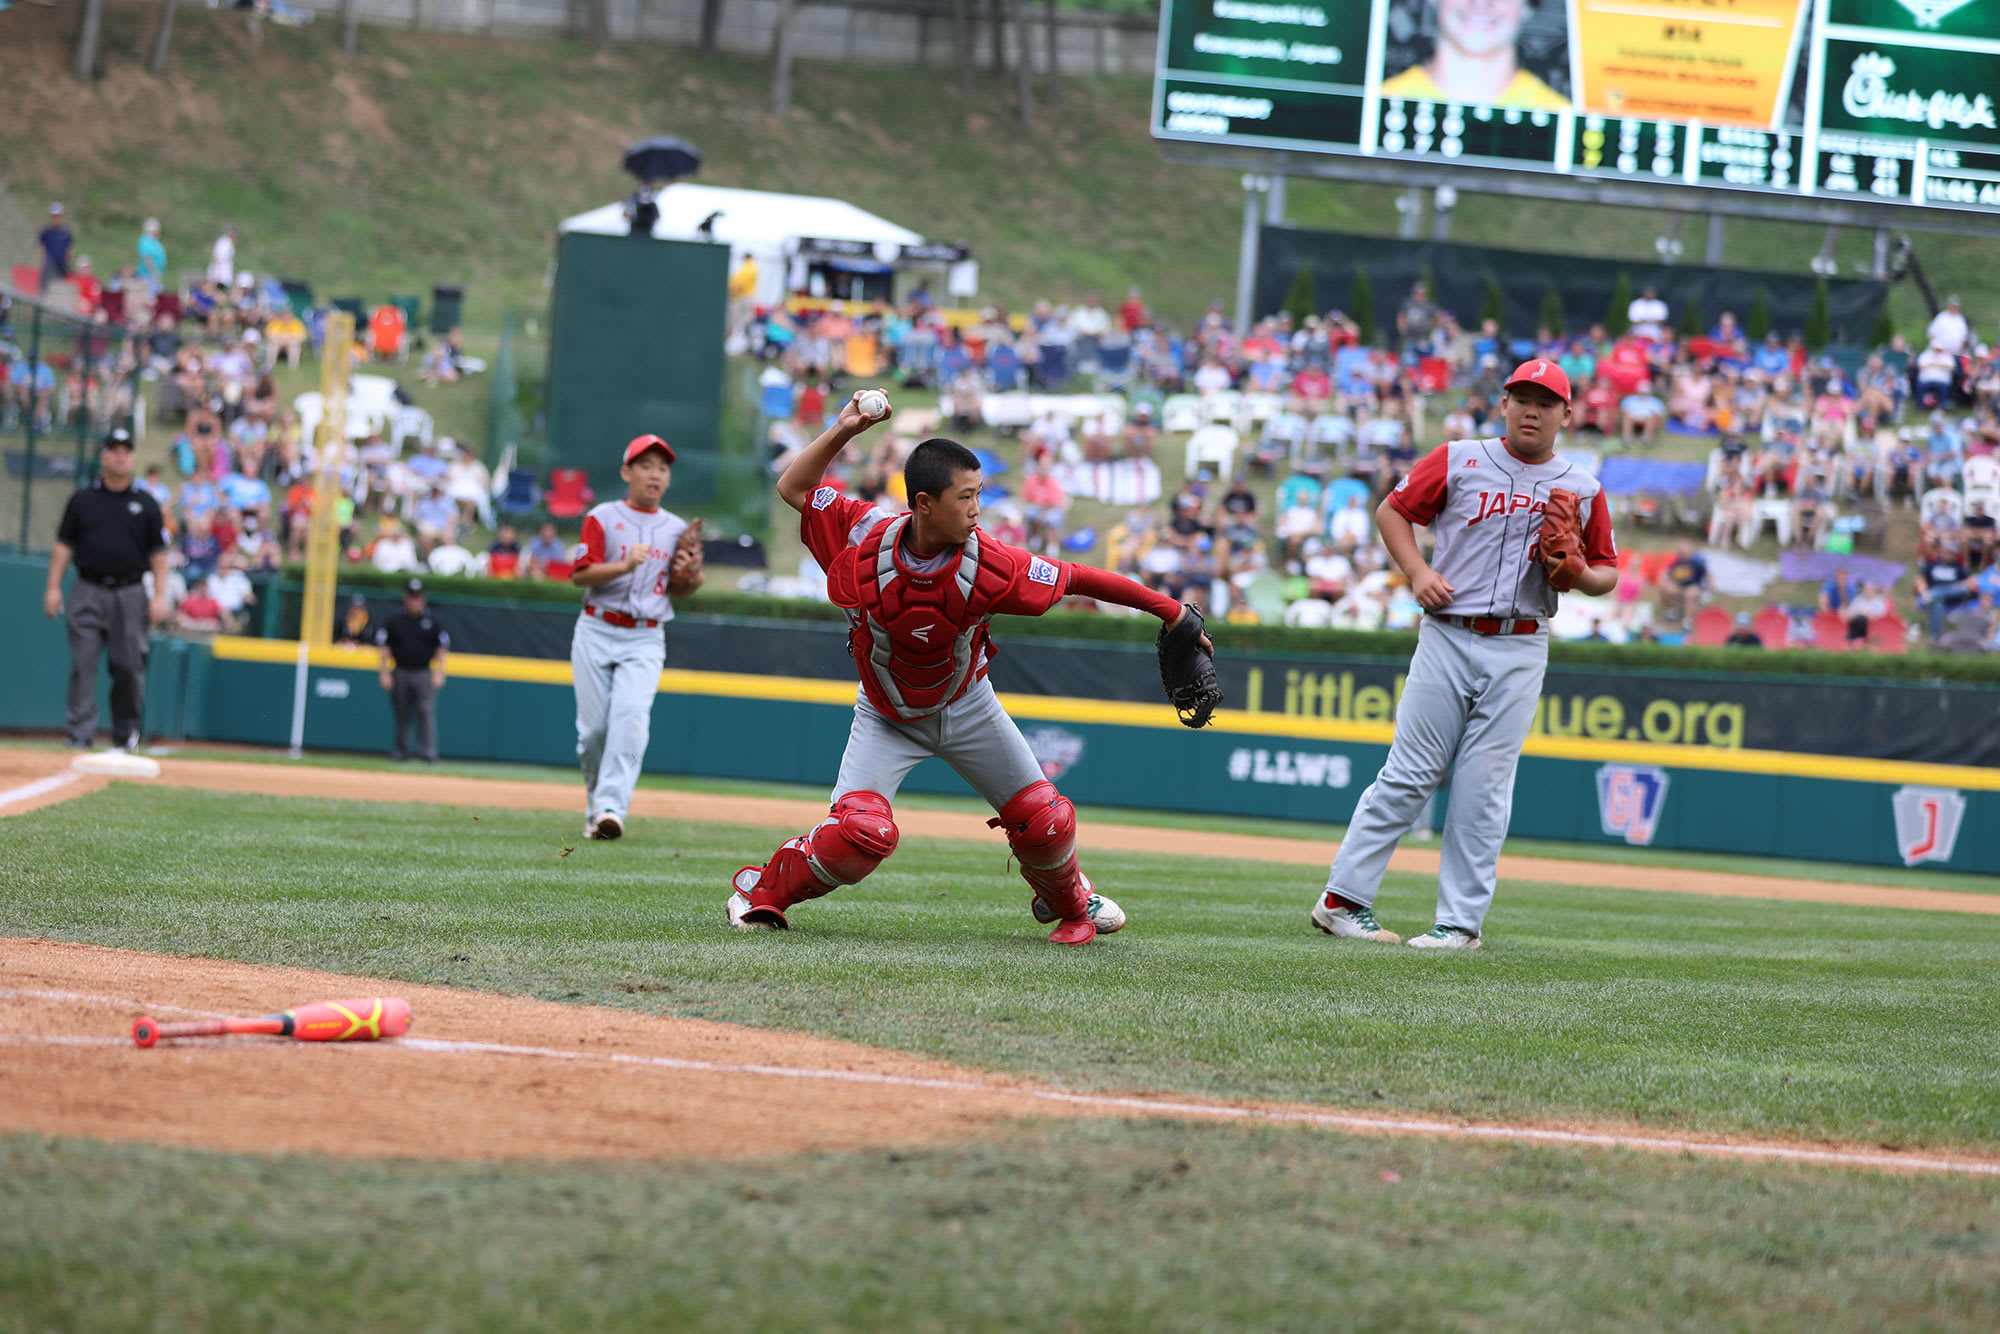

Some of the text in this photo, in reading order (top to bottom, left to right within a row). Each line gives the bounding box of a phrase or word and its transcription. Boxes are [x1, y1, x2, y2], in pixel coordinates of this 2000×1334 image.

[1531, 362, 1546, 378] J
[1467, 491, 1548, 527] JAPA
[1246, 667, 1744, 752] Littleue.org
[1228, 748, 1351, 788] #LLWS
[1908, 800, 1937, 858] J
